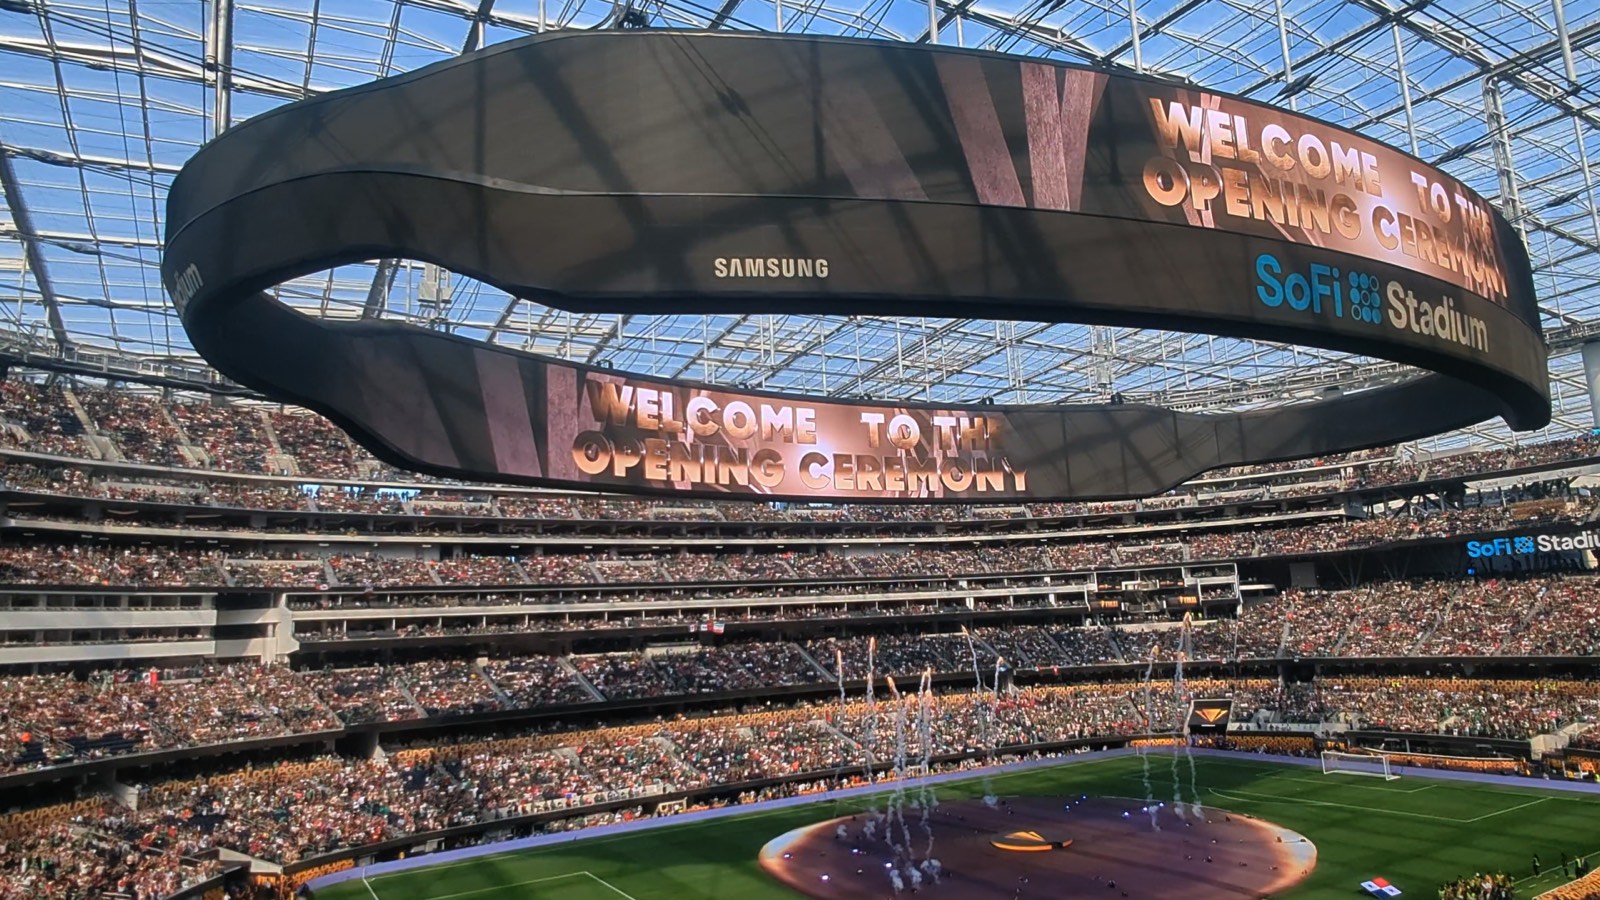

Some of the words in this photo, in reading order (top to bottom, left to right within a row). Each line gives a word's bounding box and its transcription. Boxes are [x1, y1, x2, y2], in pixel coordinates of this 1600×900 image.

[1149, 98, 1383, 197] WELCOME
[1411, 171, 1451, 224] TO
[1143, 157, 1361, 240] OPENING
[714, 257, 829, 278] SAMSUNG
[1256, 253, 1343, 318] SoFi
[1386, 280, 1489, 353] Stadium
[586, 379, 817, 446] WELCOME
[860, 412, 920, 450] TO
[572, 430, 785, 488] OPENING
[799, 451, 1027, 491] CEREMONY
[1467, 538, 1512, 558] SoFi
